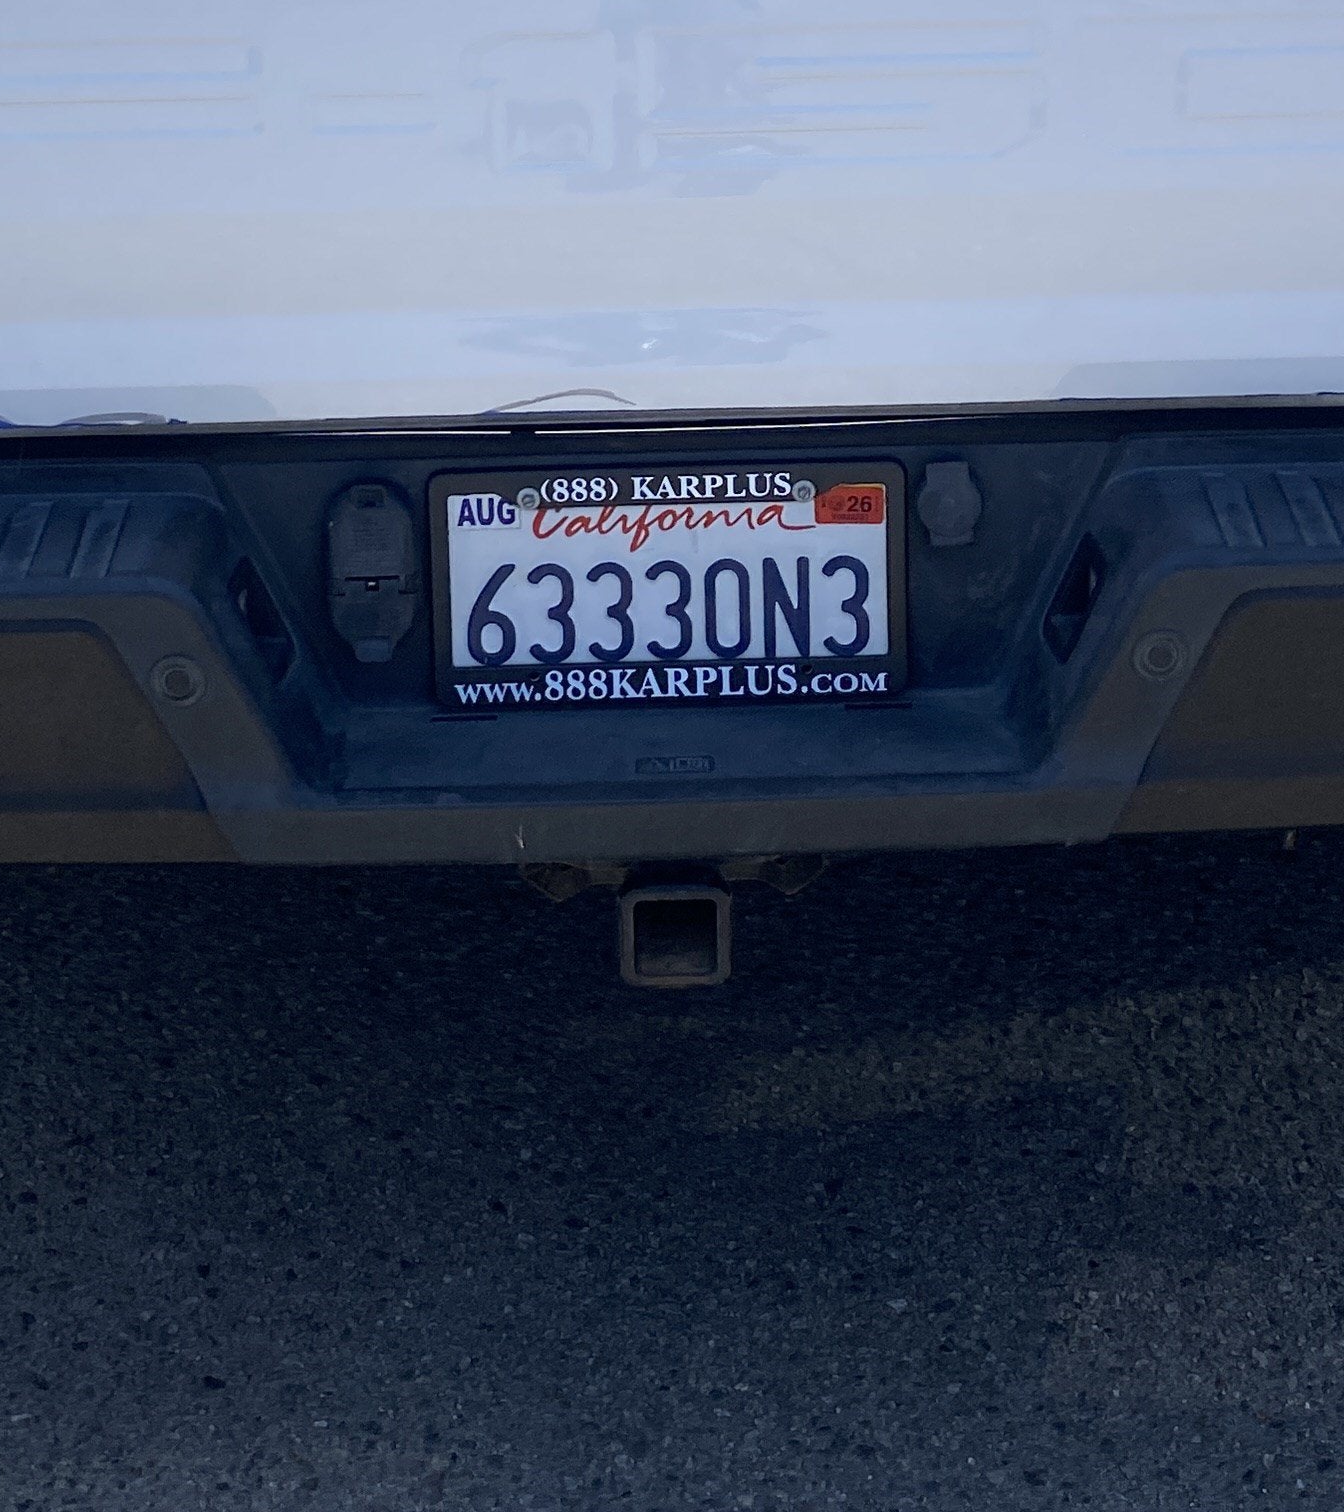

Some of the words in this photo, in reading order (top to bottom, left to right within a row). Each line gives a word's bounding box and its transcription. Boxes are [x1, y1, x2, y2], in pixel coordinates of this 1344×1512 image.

[539, 475, 619, 504] (888)
[630, 472, 793, 501] KARPLUS
[846, 495, 872, 513] 26
[457, 499, 517, 527] AUG
[532, 502, 816, 553] California
[466, 554, 870, 668] 63330N3
